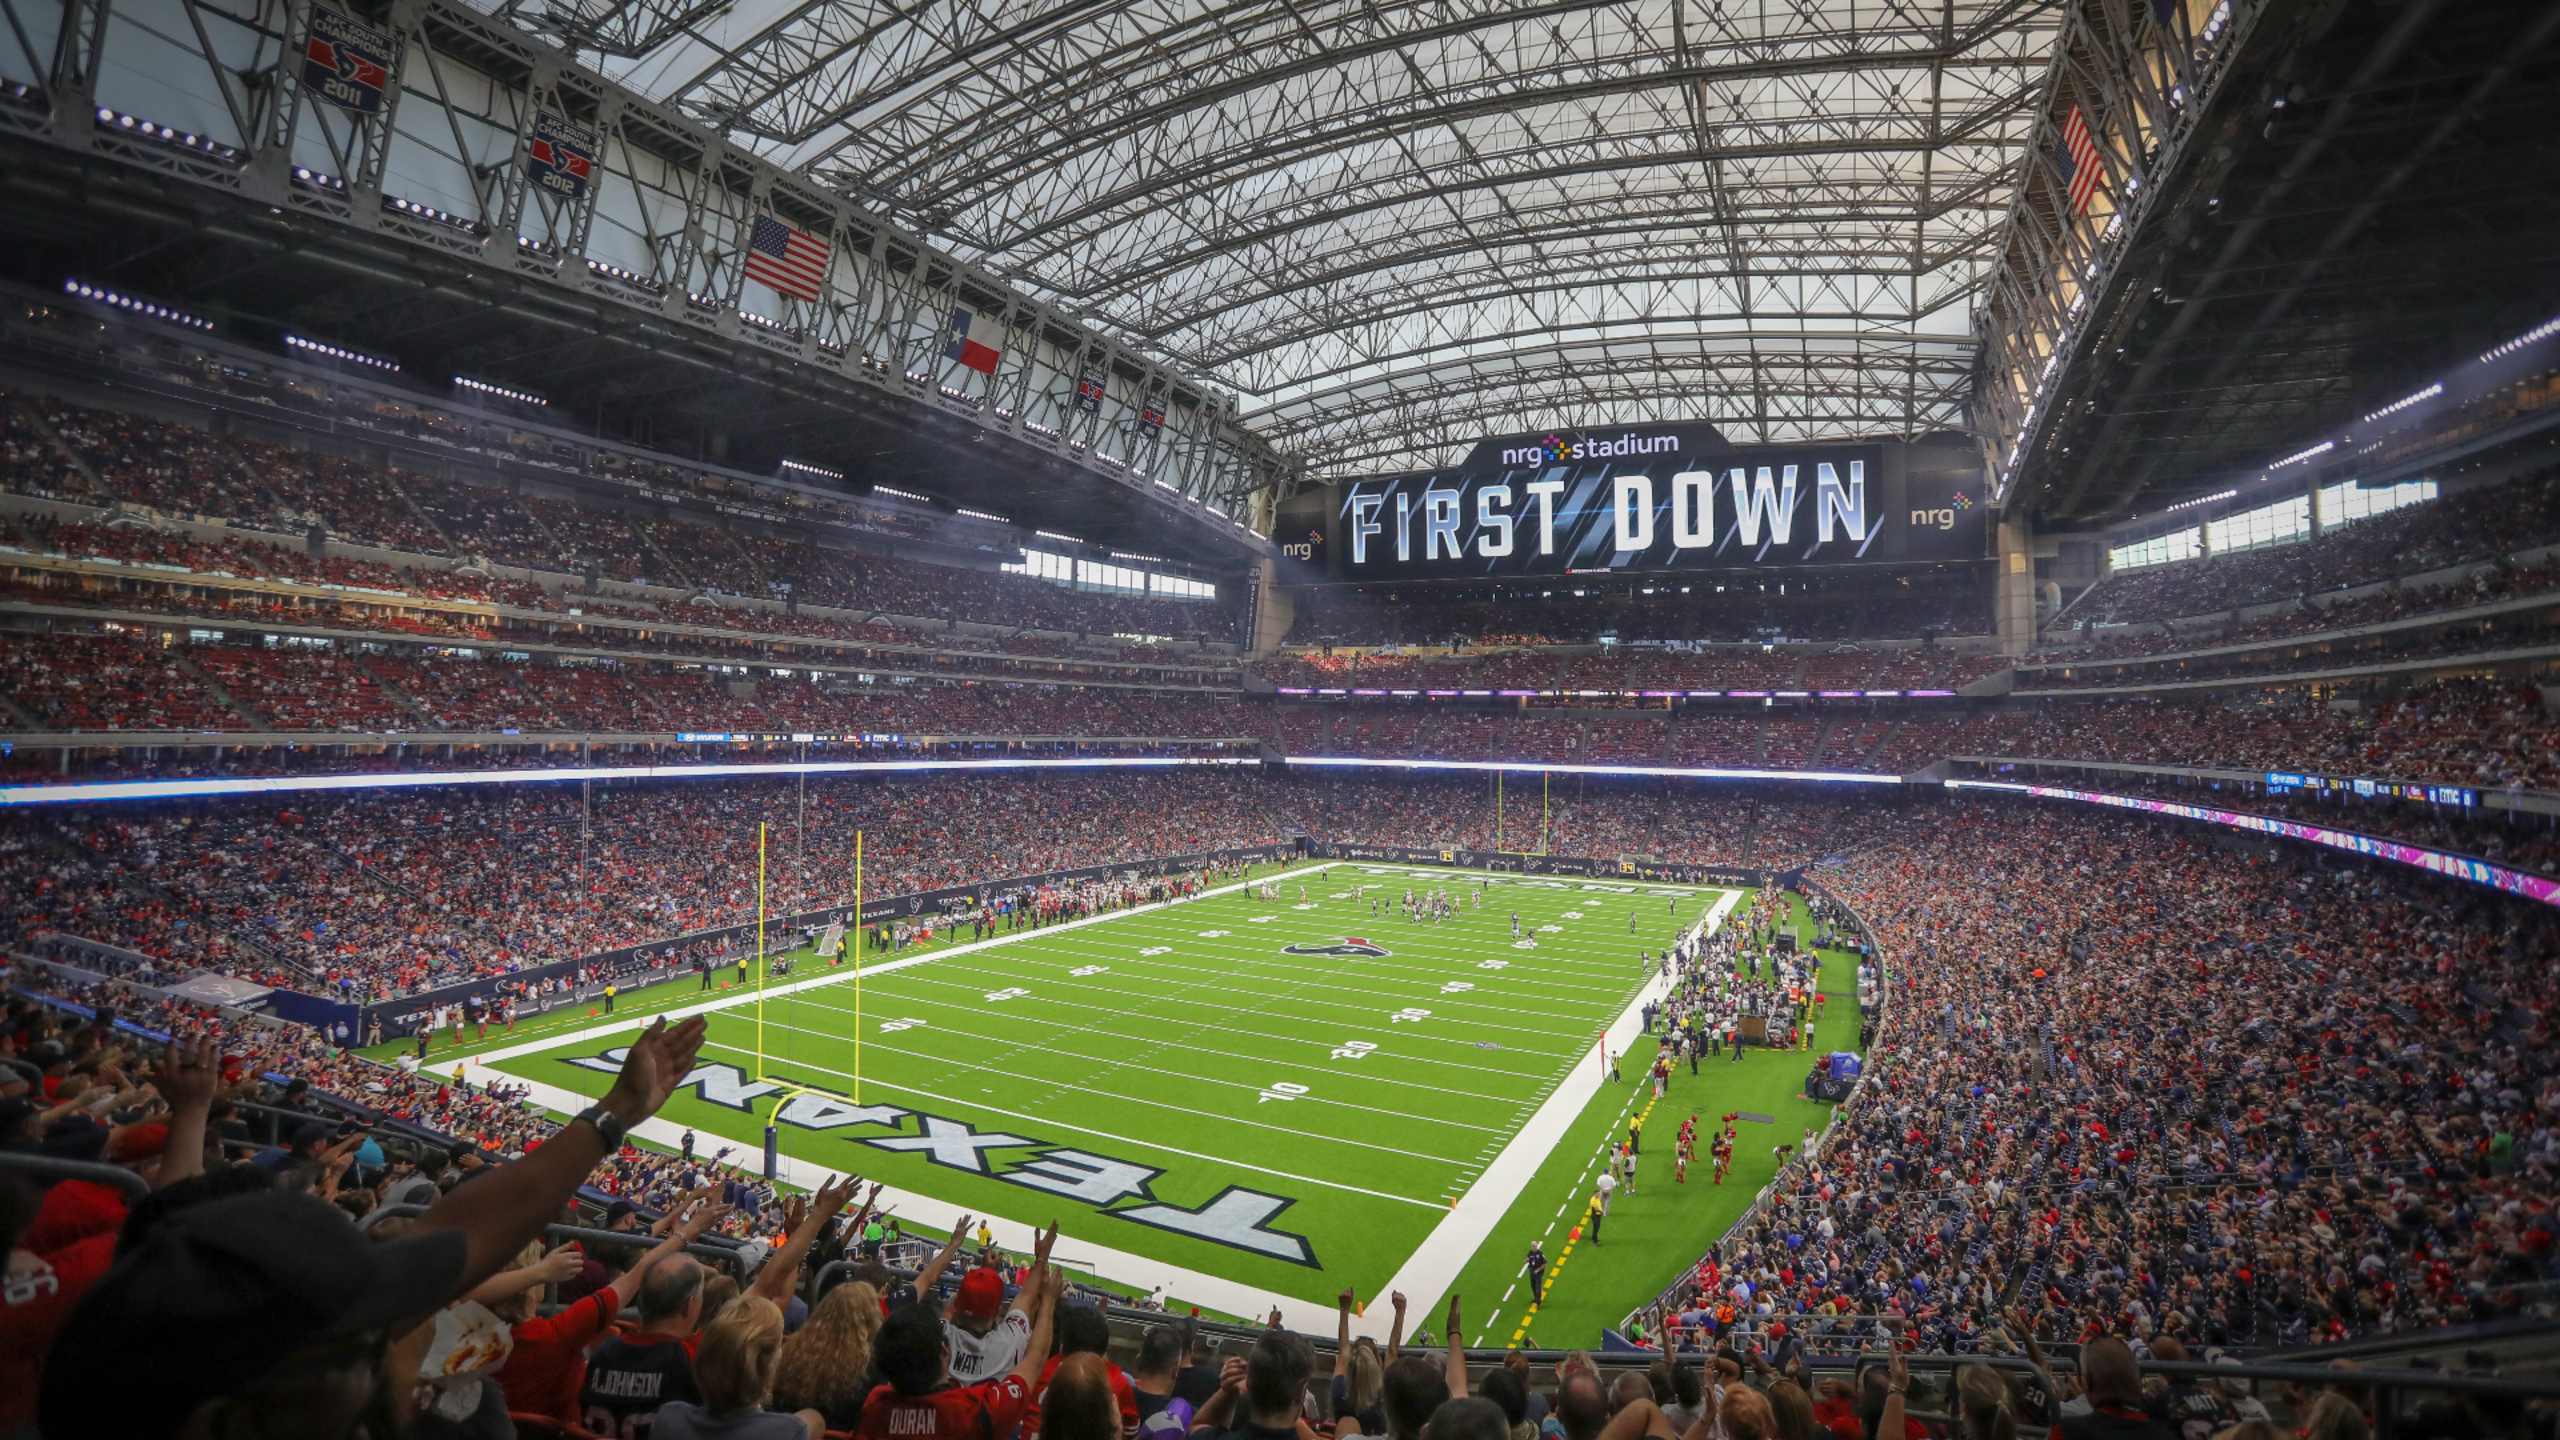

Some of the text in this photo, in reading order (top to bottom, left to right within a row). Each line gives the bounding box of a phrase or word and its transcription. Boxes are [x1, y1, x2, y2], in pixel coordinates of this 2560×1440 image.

[314, 18, 389, 60] CHAMPIONS
[324, 14, 384, 47] AFC SOUTH
[323, 78, 362, 106] 2011
[539, 123, 593, 154] CHAMPIONS
[546, 118, 591, 142] AFC SOUTH
[542, 171, 575, 194] 2012
[1502, 433, 1680, 468] nrg stadium
[1352, 459, 1867, 564] FIRST DOWN
[1911, 508, 1955, 530] nrg
[1283, 543, 1312, 560] nrg
[860, 907, 896, 920] TEXANS
[1330, 1040, 1379, 1060] 20
[1258, 1081, 1311, 1103] 10
[952, 1350, 985, 1375] WATT
[591, 1366, 664, 1398] A.JOHNSON
[888, 1407, 937, 1435] DURAN
